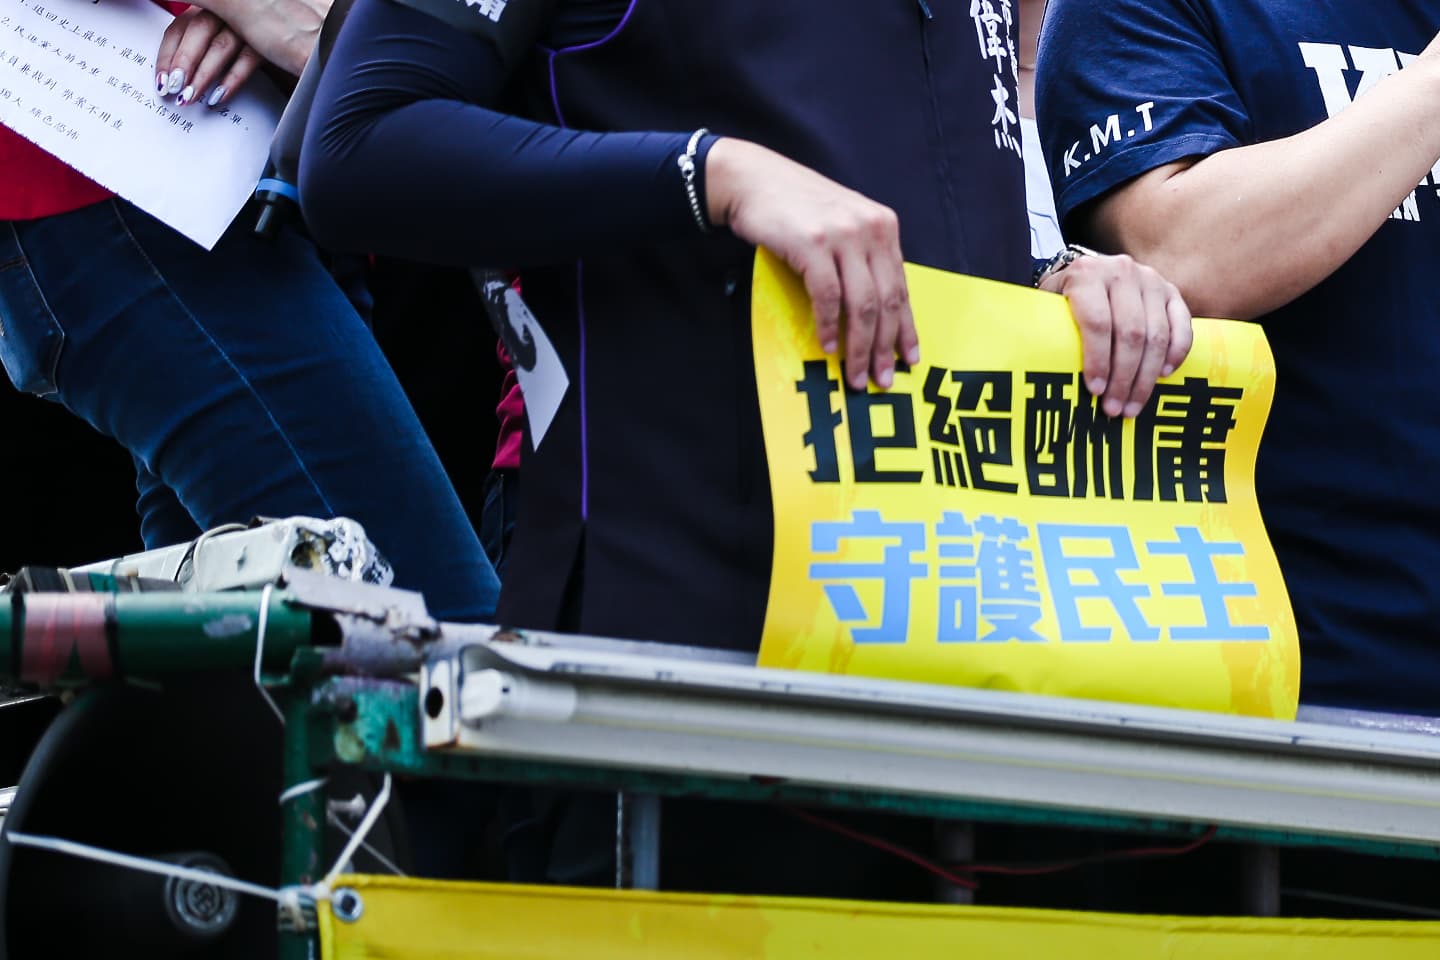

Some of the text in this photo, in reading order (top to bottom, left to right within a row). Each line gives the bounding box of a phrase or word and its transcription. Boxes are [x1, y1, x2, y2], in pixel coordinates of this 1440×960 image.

[794, 358, 1244, 504] 拒絕酬庸
[808, 509, 1271, 645] 守護民主
